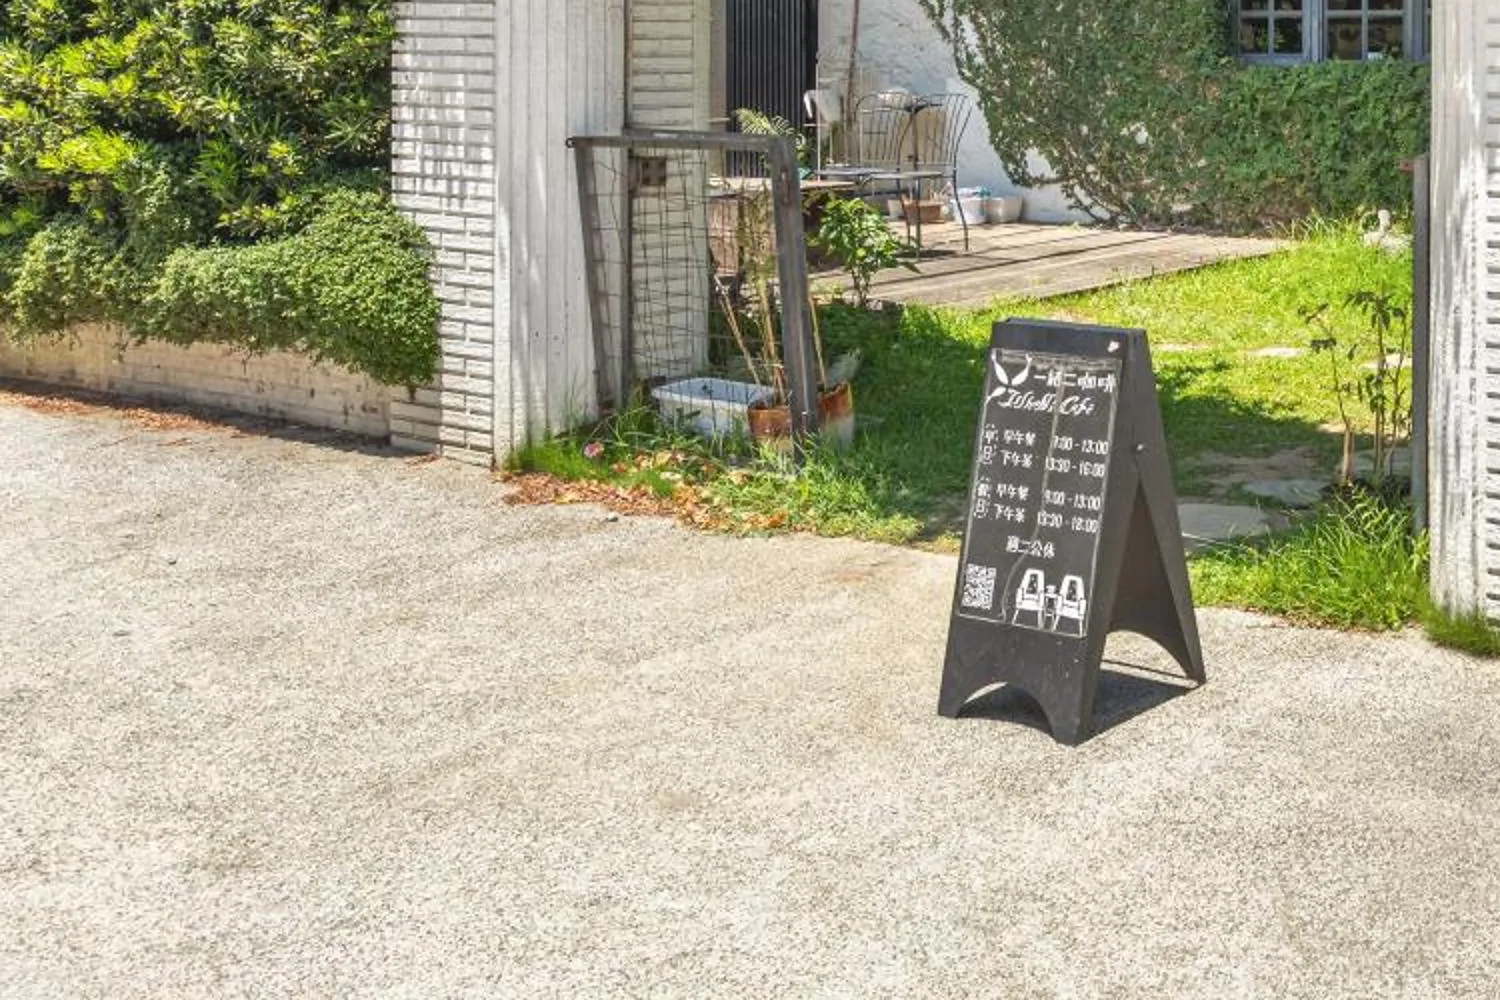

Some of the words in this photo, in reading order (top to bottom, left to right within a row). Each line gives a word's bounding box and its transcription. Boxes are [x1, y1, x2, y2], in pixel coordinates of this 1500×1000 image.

[1003, 429, 1036, 446] 早午餐
[1000, 449, 1033, 469] 下午茶
[996, 483, 1029, 501] 早午餐
[993, 503, 1026, 523] 下午茶
